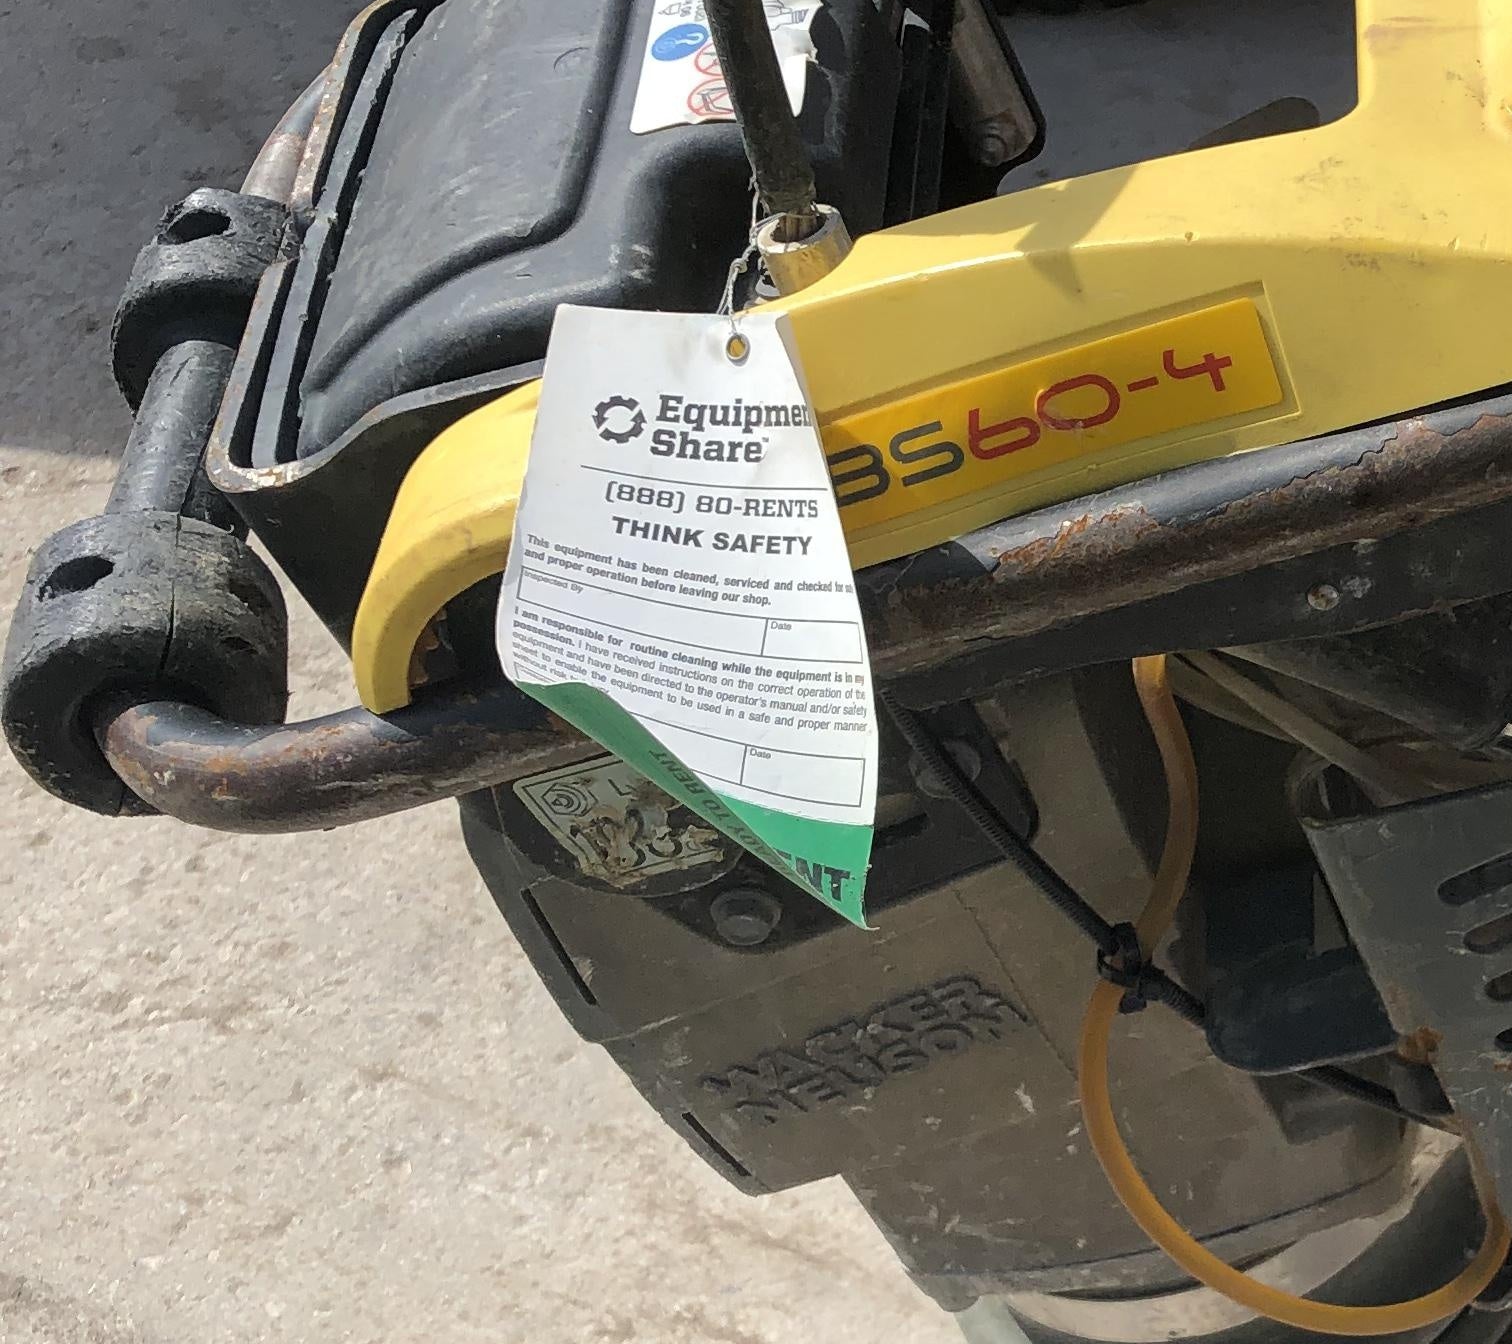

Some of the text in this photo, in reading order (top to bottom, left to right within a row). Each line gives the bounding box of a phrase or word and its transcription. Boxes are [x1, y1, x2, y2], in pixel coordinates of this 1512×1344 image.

[605, 481, 819, 518] (888) 80-RENTS
[612, 516, 812, 556] THINK SAFETY
[524, 547, 771, 607] and proper operation before leaving our shop.
[527, 533, 549, 549] This
[554, 543, 613, 565] equipment
[617, 558, 637, 570] has
[642, 562, 669, 577] been
[673, 568, 719, 586] cleaned,
[724, 576, 770, 590] serviced
[774, 580, 793, 591] and
[797, 580, 832, 593] checked
[570, 580, 584, 595] By
[522, 609, 538, 622] am
[541, 615, 604, 642] responsible
[607, 633, 623, 647] for
[629, 641, 669, 659] routine
[671, 651, 718, 671] cleaning
[722, 660, 752, 675] while
[755, 665, 772, 677] the
[775, 668, 832, 685] equipment
[834, 670, 843, 683] is
[845, 671, 853, 683] in
[770, 620, 792, 631] Date
[513, 619, 575, 647] possession.
[585, 641, 610, 658] have
[613, 650, 655, 670] received
[658, 661, 718, 685] instructions
[721, 677, 734, 688] on
[737, 678, 754, 690] the
[757, 682, 794, 696] correct
[797, 685, 842, 701] operation
[844, 688, 853, 699] of
[513, 630, 564, 656] equipment
[566, 649, 586, 663] and
[587, 656, 612, 672] have
[614, 664, 639, 679] been
[641, 672, 682, 690] directed
[684, 682, 695, 694] to
[697, 685, 714, 699] the
[769, 698, 808, 713] manual
[809, 702, 841, 715] and/or
[843, 703, 867, 718] safety
[550, 667, 567, 680] risk
[541, 651, 552, 662] to
[555, 657, 588, 676] enable
[590, 669, 608, 683] the
[610, 677, 664, 701] equipment
[666, 692, 677, 703] to
[680, 696, 693, 708] be
[697, 700, 722, 715] used
[725, 705, 735, 717] in
[748, 711, 771, 724] safe
[774, 714, 794, 727] and
[797, 718, 832, 735] proper
[648, 749, 706, 795] RENT
[750, 747, 772, 760] Date
